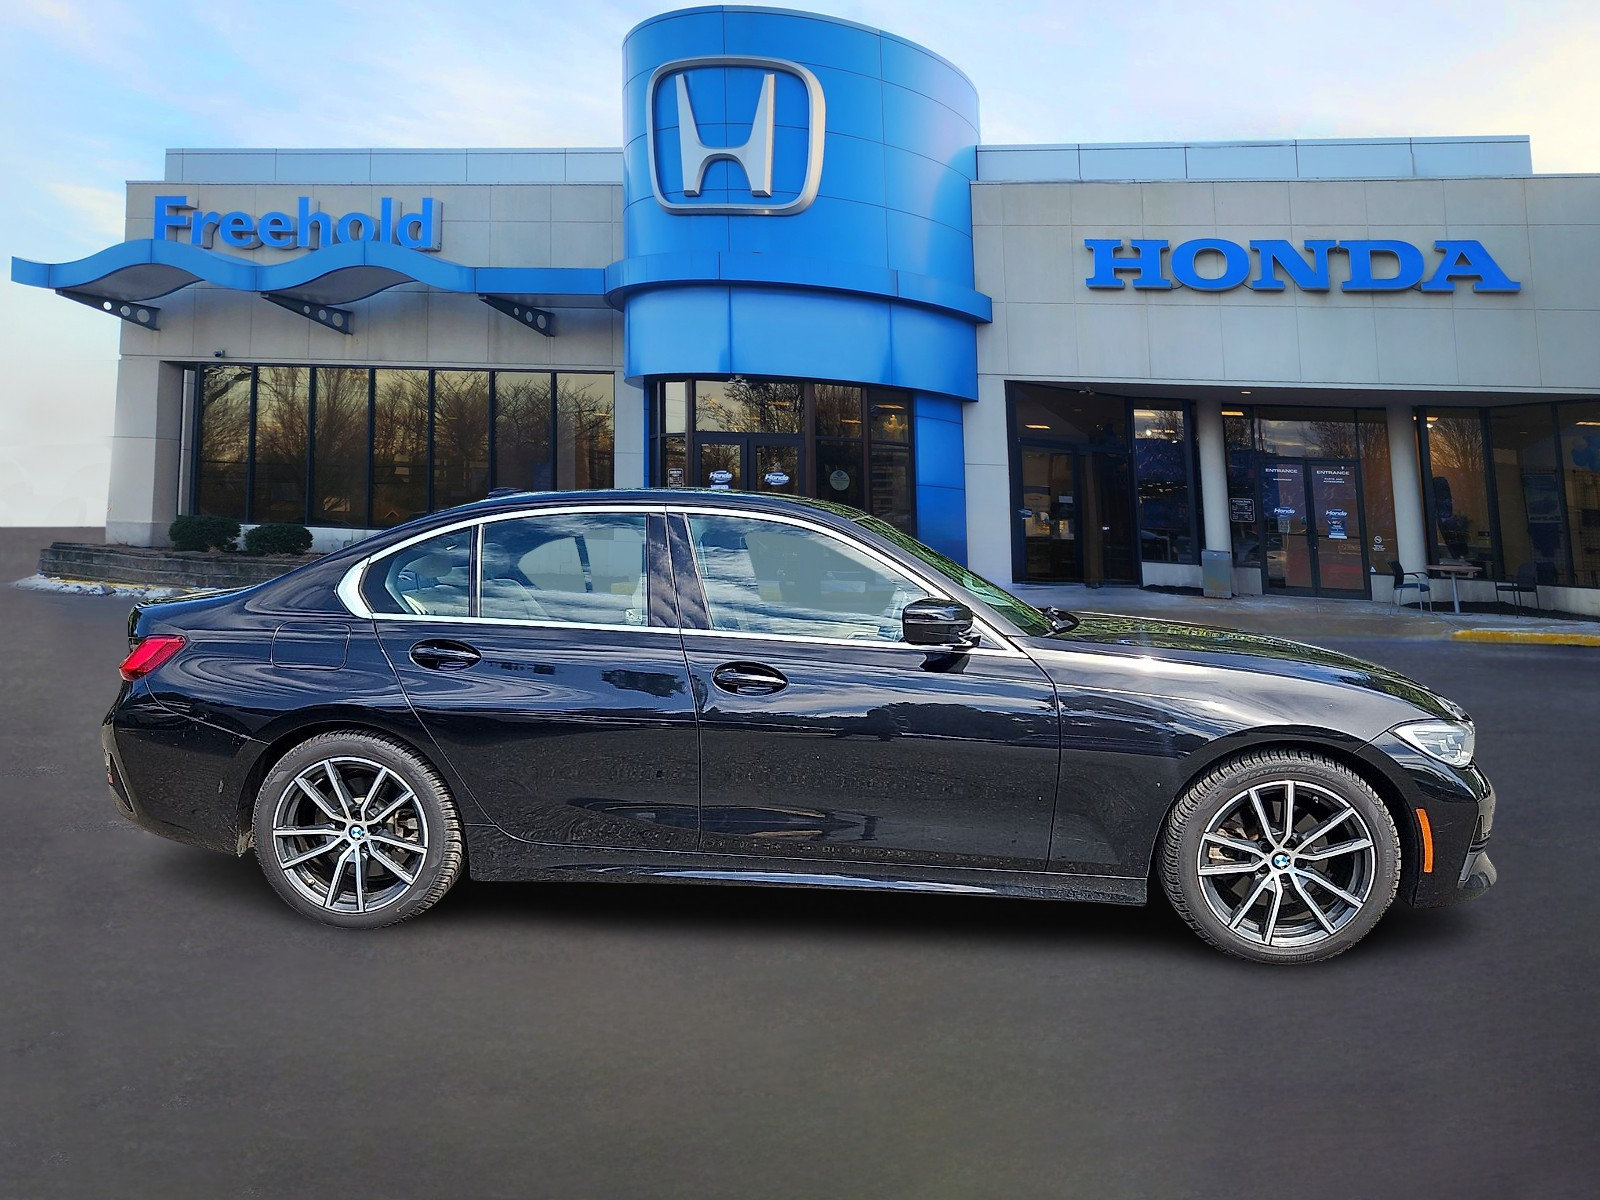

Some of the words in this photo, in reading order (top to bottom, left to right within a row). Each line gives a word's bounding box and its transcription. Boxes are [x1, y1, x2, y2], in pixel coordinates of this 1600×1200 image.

[152, 195, 442, 251] Freehold
[1084, 238, 1521, 292] HONDA
[709, 471, 733, 479] Honda
[764, 473, 790, 481] Honda
